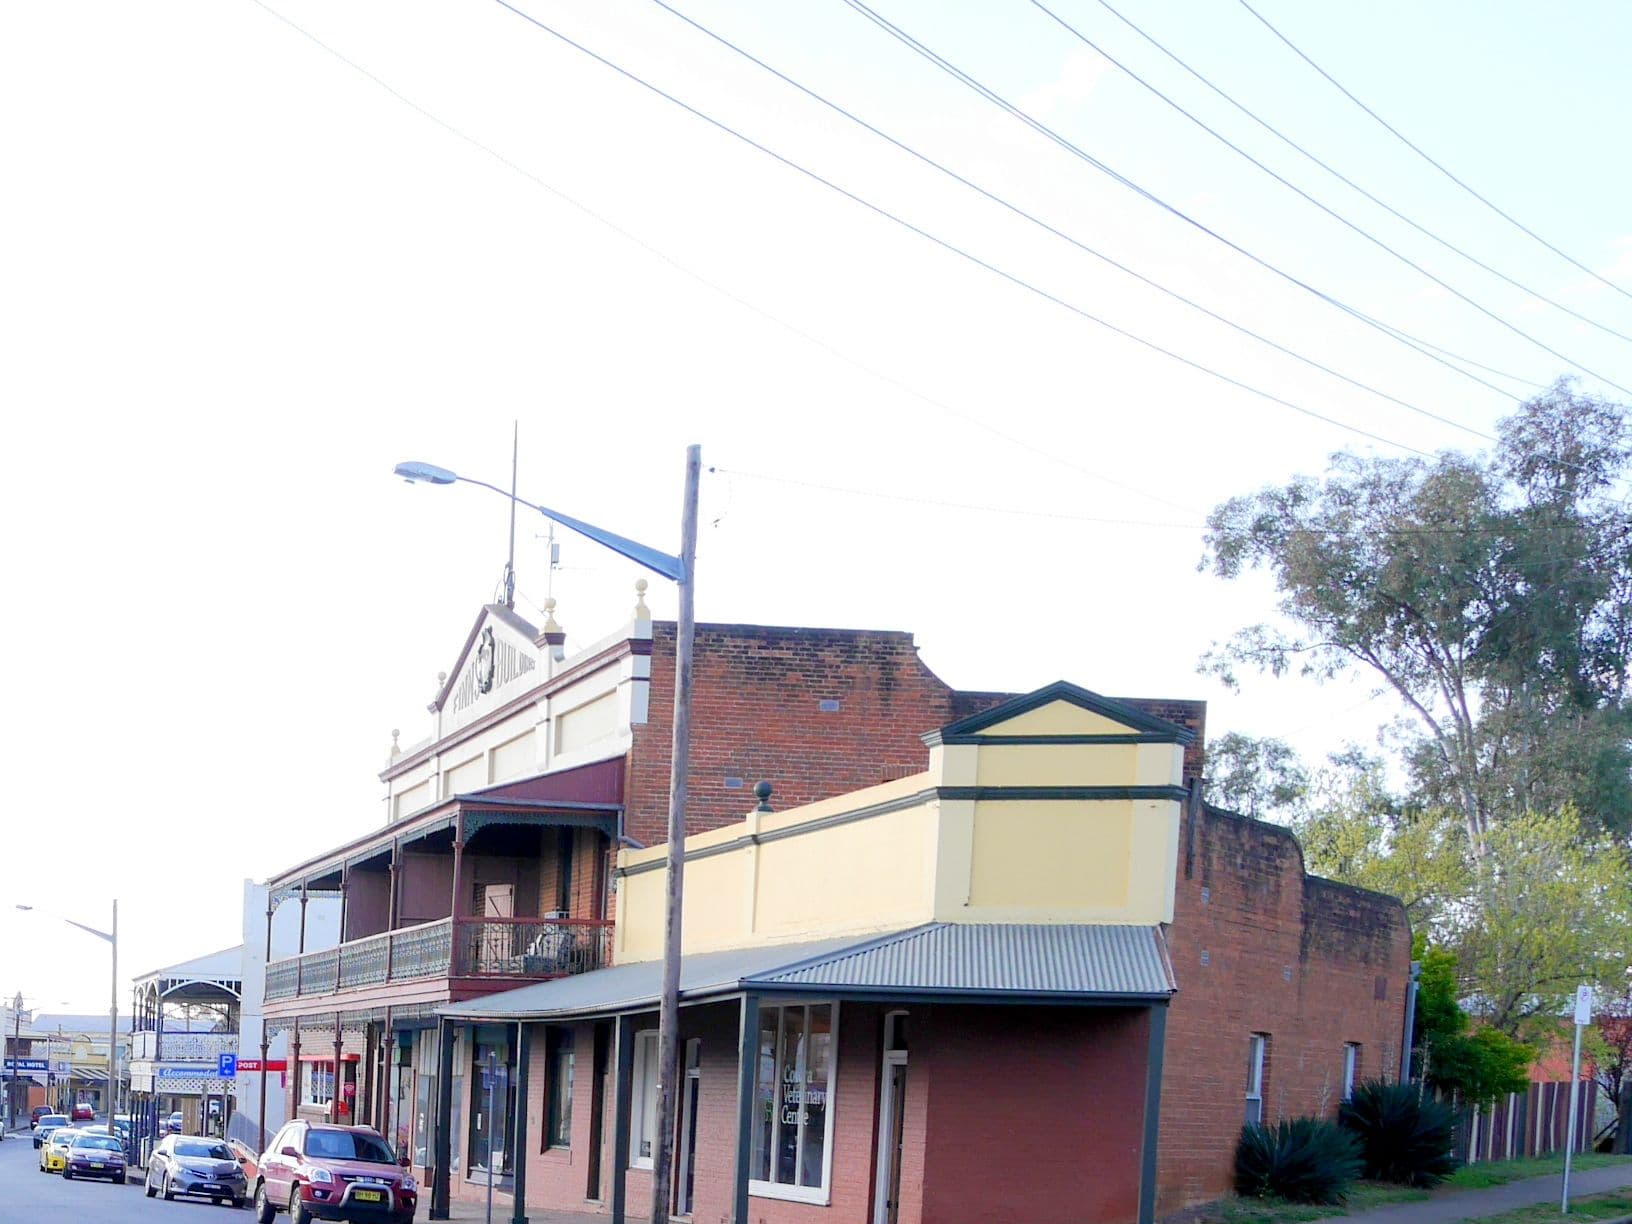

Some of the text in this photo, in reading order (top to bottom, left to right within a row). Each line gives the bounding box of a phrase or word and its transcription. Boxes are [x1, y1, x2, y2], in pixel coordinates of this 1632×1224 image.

[222, 1055, 233, 1068] P
[238, 1061, 258, 1069] POST
[163, 1068, 218, 1078] Accommodat
[783, 1064, 814, 1084] Coa
[783, 1084, 827, 1112] Veteinary
[781, 1104, 810, 1126] Cene
